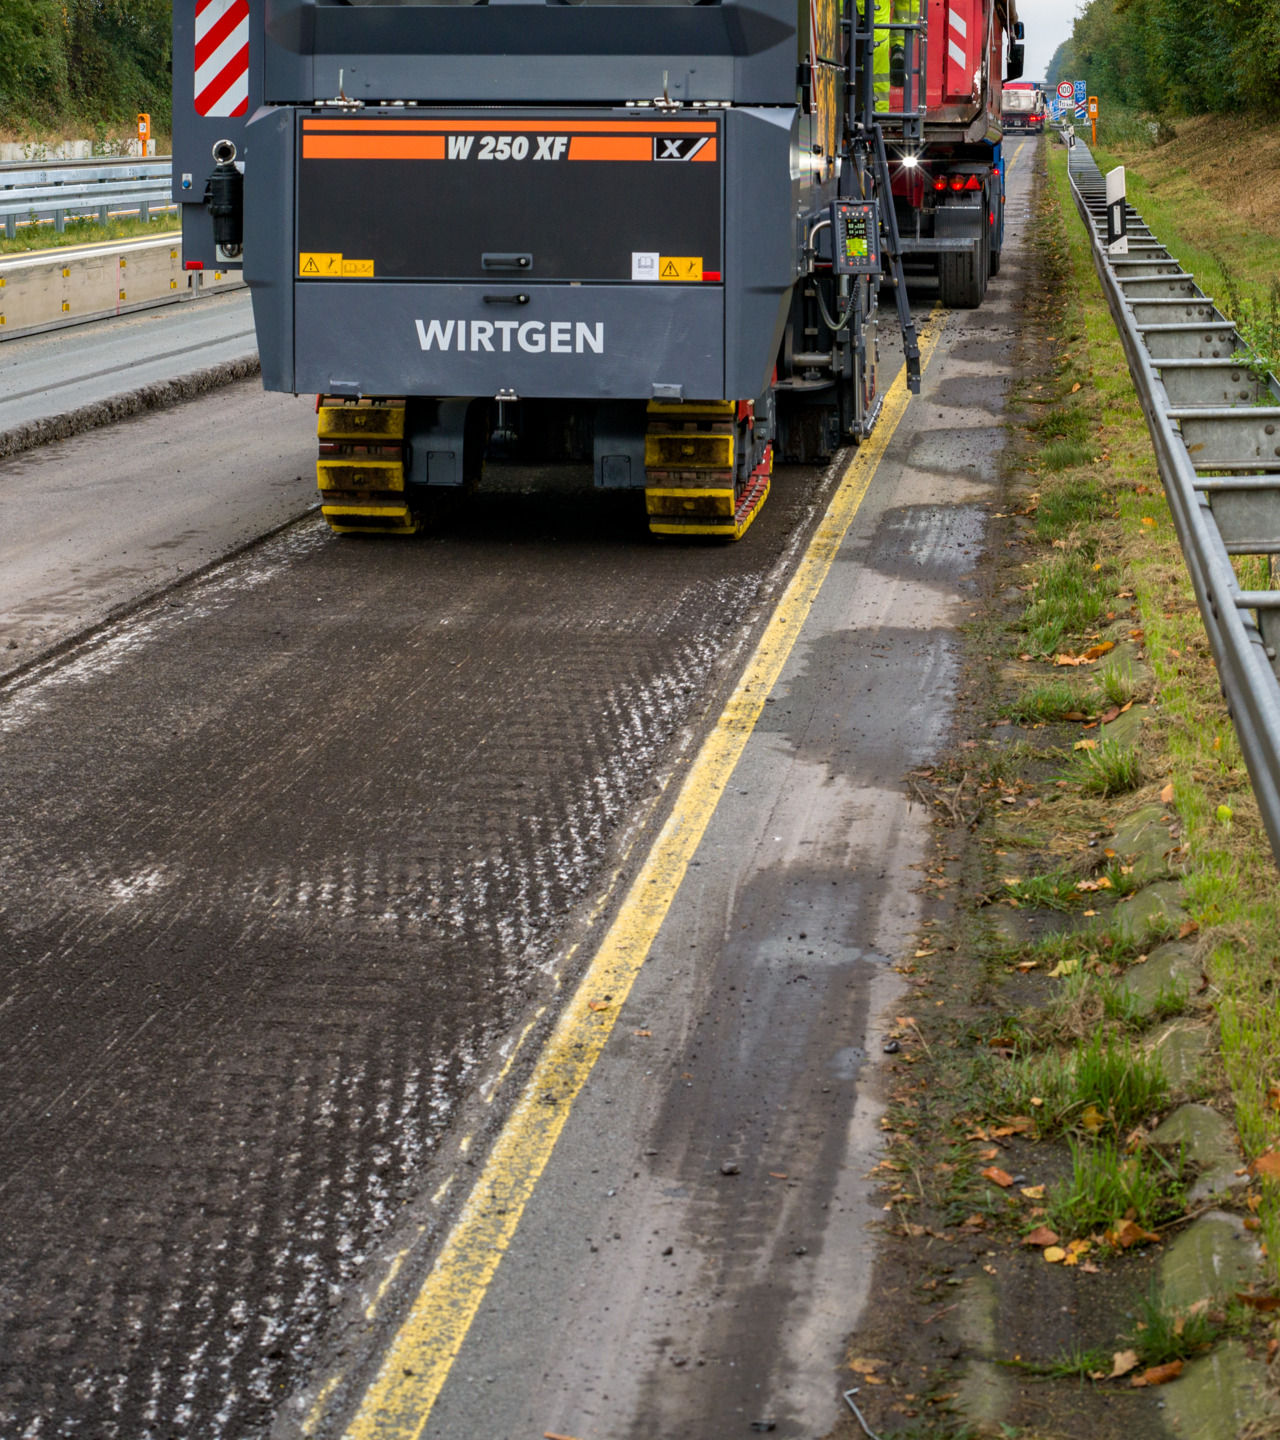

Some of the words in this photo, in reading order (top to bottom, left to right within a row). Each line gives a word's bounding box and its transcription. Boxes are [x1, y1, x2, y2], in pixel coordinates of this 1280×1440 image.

[448, 135, 475, 160] W
[477, 135, 530, 161] 250
[533, 136, 569, 161] XF
[414, 319, 604, 354] WIRTGEN
